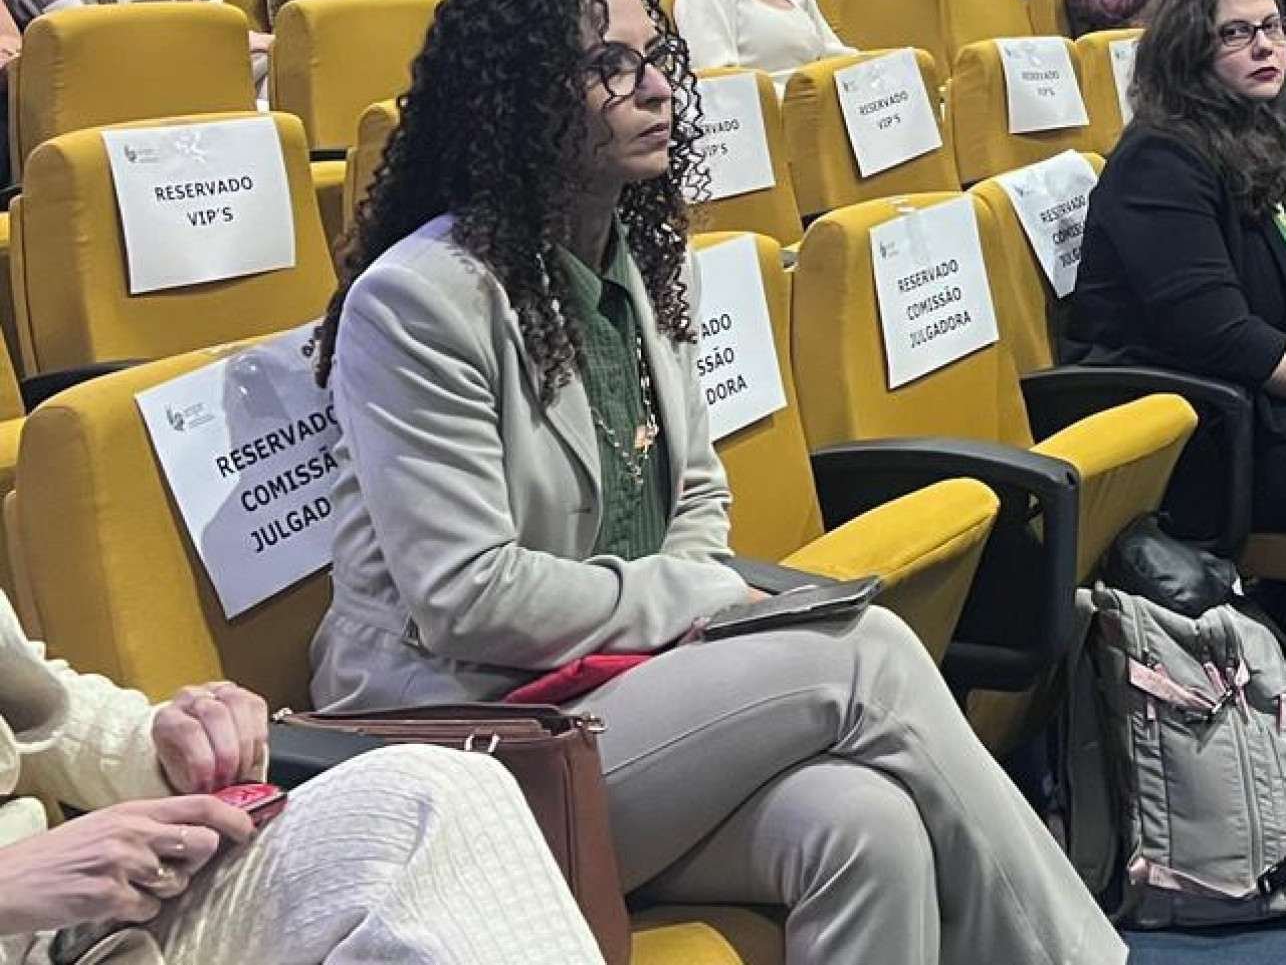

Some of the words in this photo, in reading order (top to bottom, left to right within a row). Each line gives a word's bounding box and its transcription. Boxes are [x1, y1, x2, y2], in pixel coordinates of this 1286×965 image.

[154, 176, 254, 202] RESERVADO
[187, 207, 234, 227] VIP'S
[897, 259, 959, 292] RESERVADO
[906, 286, 962, 321] COMISSÃO
[909, 310, 972, 348] JULGADORA
[696, 346, 735, 377] SSÃO
[240, 445, 339, 512] COMISSÃ
[250, 495, 332, 554] JULGAD
